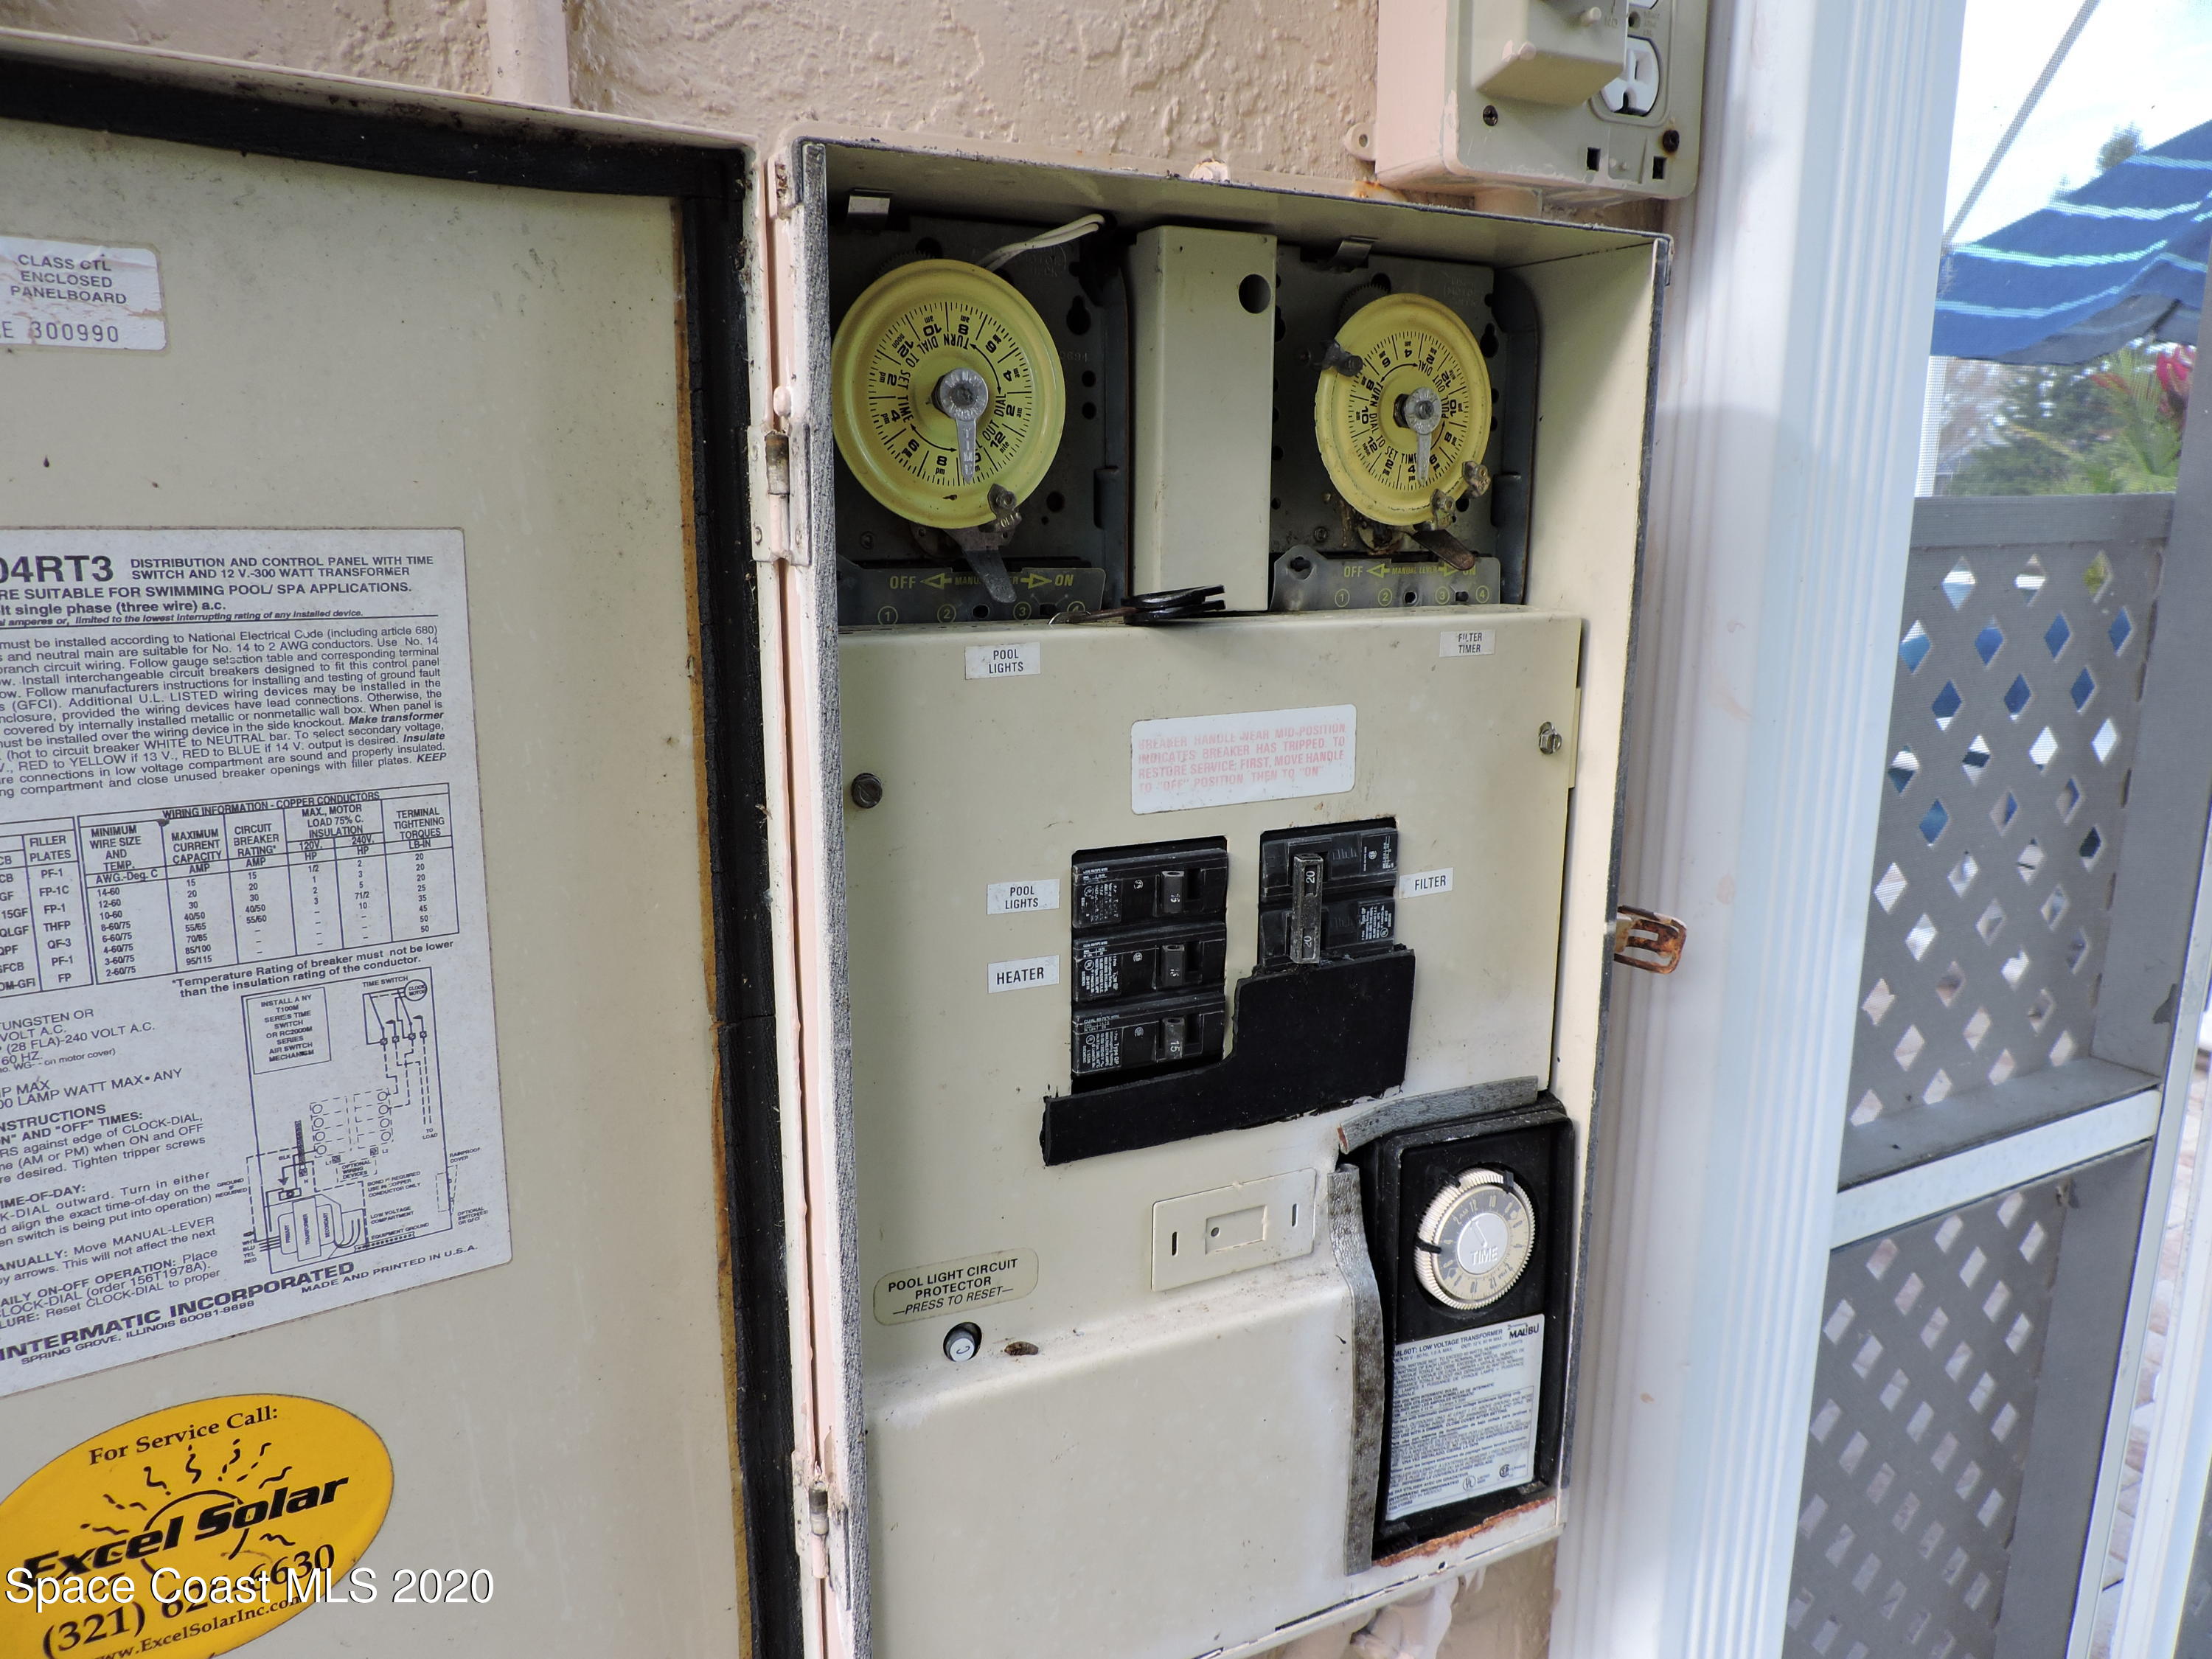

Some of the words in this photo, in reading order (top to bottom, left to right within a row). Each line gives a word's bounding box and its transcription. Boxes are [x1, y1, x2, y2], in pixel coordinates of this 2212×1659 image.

[18, 254, 74, 270] CLASS
[80, 260, 112, 271] CTL
[21, 271, 112, 288] ENCLOSED
[10, 285, 127, 304] PANELBOARD
[30, 321, 119, 343] 300990
[922, 324, 942, 337] 10
[917, 336, 939, 355] DIAL
[944, 333, 970, 350] TURN
[898, 369, 911, 390] SET
[1370, 381, 1383, 407] TURN
[897, 395, 914, 422] TIME
[982, 421, 999, 441] OUT
[995, 394, 1006, 417] DIAL
[1368, 412, 1377, 434] DIAL
[1385, 445, 1399, 461] SET
[131, 558, 225, 568] DISTRIBUTION
[230, 557, 257, 567] AND
[262, 557, 324, 567] CONTROL
[327, 556, 368, 566] PANEL
[372, 556, 402, 566] WITH
[406, 556, 434, 565] TIME
[132, 569, 184, 580] SWITCH
[189, 569, 217, 579] AND
[221, 569, 234, 578] 12
[238, 568, 275, 578] V.-300
[279, 568, 315, 577] WATT
[318, 567, 410, 577] TRANSFORMER
[1344, 566, 1363, 578] OFF
[890, 575, 916, 589] OFF
[1055, 574, 1074, 586] ON
[24, 588, 104, 599] SUITABLE
[109, 587, 142, 597] FOR
[145, 585, 225, 597] SWIMMING
[229, 584, 273, 595] POOL/
[277, 583, 306, 594] SPA
[310, 582, 412, 594] APPLICATIONS.
[15, 602, 62, 617] single
[66, 602, 112, 616] phase
[116, 600, 159, 615] (three
[163, 600, 198, 613] wire)
[201, 602, 226, 611] a.c.
[1458, 633, 1482, 642] FILTER
[993, 649, 1019, 660] POOL
[1458, 644, 1481, 653] TIMER
[989, 661, 1023, 674] LIGHTS
[349, 715, 378, 725] Make
[380, 712, 444, 723] transformer
[403, 732, 445, 742] Insulate
[1203, 745, 1250, 759] BREAKER
[1256, 742, 1277, 754] HAS
[1284, 738, 1325, 752] TRIPPED
[417, 752, 447, 762] KEEP
[1274, 754, 1304, 766] MOVE
[1306, 750, 1344, 763] HANDLE
[1194, 773, 1243, 787] POSITION
[162, 808, 198, 818] WIRING
[202, 801, 268, 816] INFORMATION
[276, 797, 319, 809] COPPER
[318, 792, 380, 804] CONDUCTORS
[397, 807, 439, 818] TERMINAL
[394, 818, 445, 830] TIGHTENING
[29, 835, 66, 847] FILLER
[172, 829, 218, 841] MAXIMUM
[400, 828, 441, 841] TORQUES
[173, 839, 220, 852] CURRENT
[29, 850, 71, 862] PLATES
[173, 851, 221, 863] CAPACITY
[1306, 870, 1315, 884] 20
[1414, 875, 1447, 891] FILTER
[1010, 886, 1034, 897] POOL
[1005, 898, 1038, 909] LIGHTS
[44, 921, 71, 932] THFP
[47, 939, 72, 949] QF-3
[1304, 935, 1312, 948] 20
[257, 964, 294, 978] Rating
[297, 961, 308, 970] of
[310, 955, 352, 969] breaker
[356, 950, 383, 962] must
[389, 947, 406, 959] not
[409, 946, 423, 956] be
[425, 940, 453, 953] lower
[181, 987, 207, 998] than
[211, 984, 229, 995] the
[232, 974, 291, 990] insulation
[293, 969, 327, 984] rating
[329, 966, 341, 976] of
[343, 963, 361, 973] the
[364, 955, 421, 970] conductor.
[997, 967, 1044, 985] HEATER
[1170, 1040, 1180, 1051] 15
[18, 1090, 60, 1106] LAMP
[63, 1081, 107, 1097] WATT
[1472, 1247, 1498, 1265] TIME
[301, 1279, 339, 1293] MADE
[342, 1272, 369, 1283] AND
[372, 1258, 425, 1276] PRINTED
[444, 1245, 478, 1256] U.S.A.
[888, 1278, 923, 1292] POOL
[927, 1269, 963, 1284] LIGHT
[967, 1258, 1018, 1276] CIRCUIT
[916, 1276, 992, 1300] PROTECTOR
[948, 1295, 962, 1305] TO
[0, 1310, 161, 1361] INTERMATIC
[170, 1262, 355, 1318] INCORPORATED
[1509, 1324, 1540, 1339] MALIBU
[21, 1347, 71, 1365] SPRING
[75, 1335, 121, 1352] GROVE,
[126, 1320, 175, 1338] ILLINOIS
[1419, 1344, 1432, 1352] LOW
[1433, 1338, 1459, 1349] VOLTAGE
[1461, 1329, 1503, 1343] TRANSFORMER
[88, 1443, 128, 1465] For
[136, 1420, 220, 1453] Service
[226, 1406, 279, 1429] Call:
[17, 1517, 181, 1593] Excel
[195, 1477, 349, 1541] Solar
[43, 1601, 146, 1659] (321)
[161, 1544, 335, 1620] 62-6630
